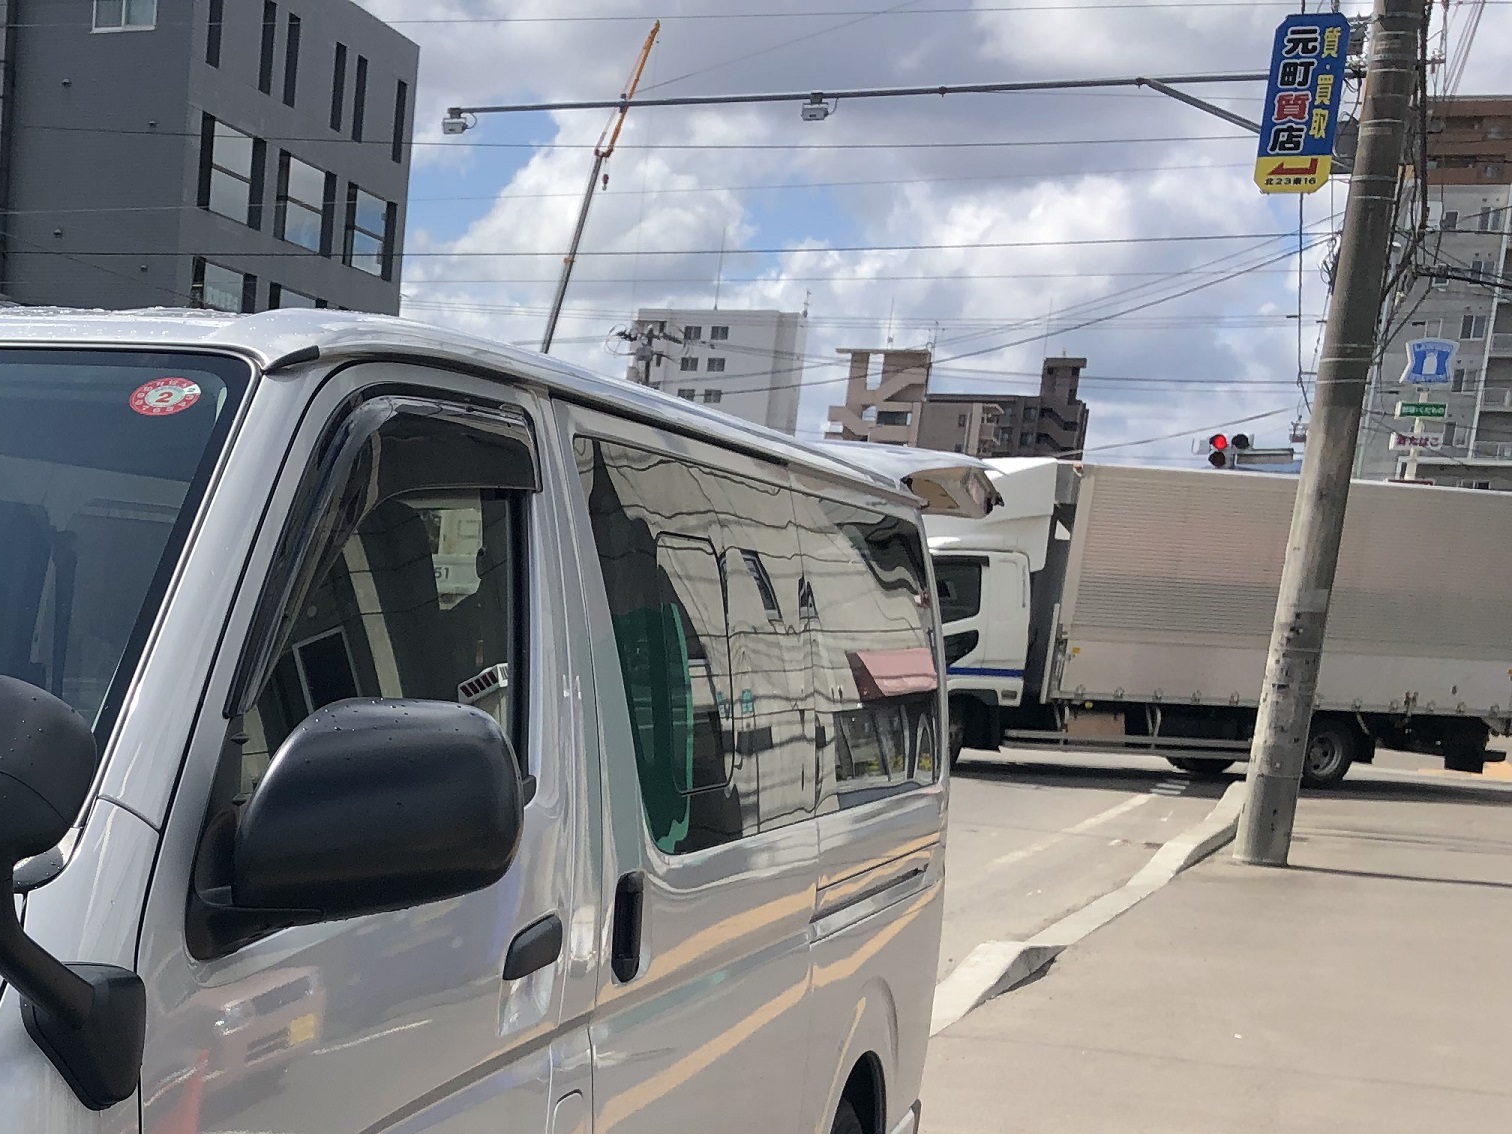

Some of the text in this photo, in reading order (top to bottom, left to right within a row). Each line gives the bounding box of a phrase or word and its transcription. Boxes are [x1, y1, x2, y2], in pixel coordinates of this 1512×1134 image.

[1268, 26, 1320, 154] 元町質店
[155, 391, 174, 403] 2
